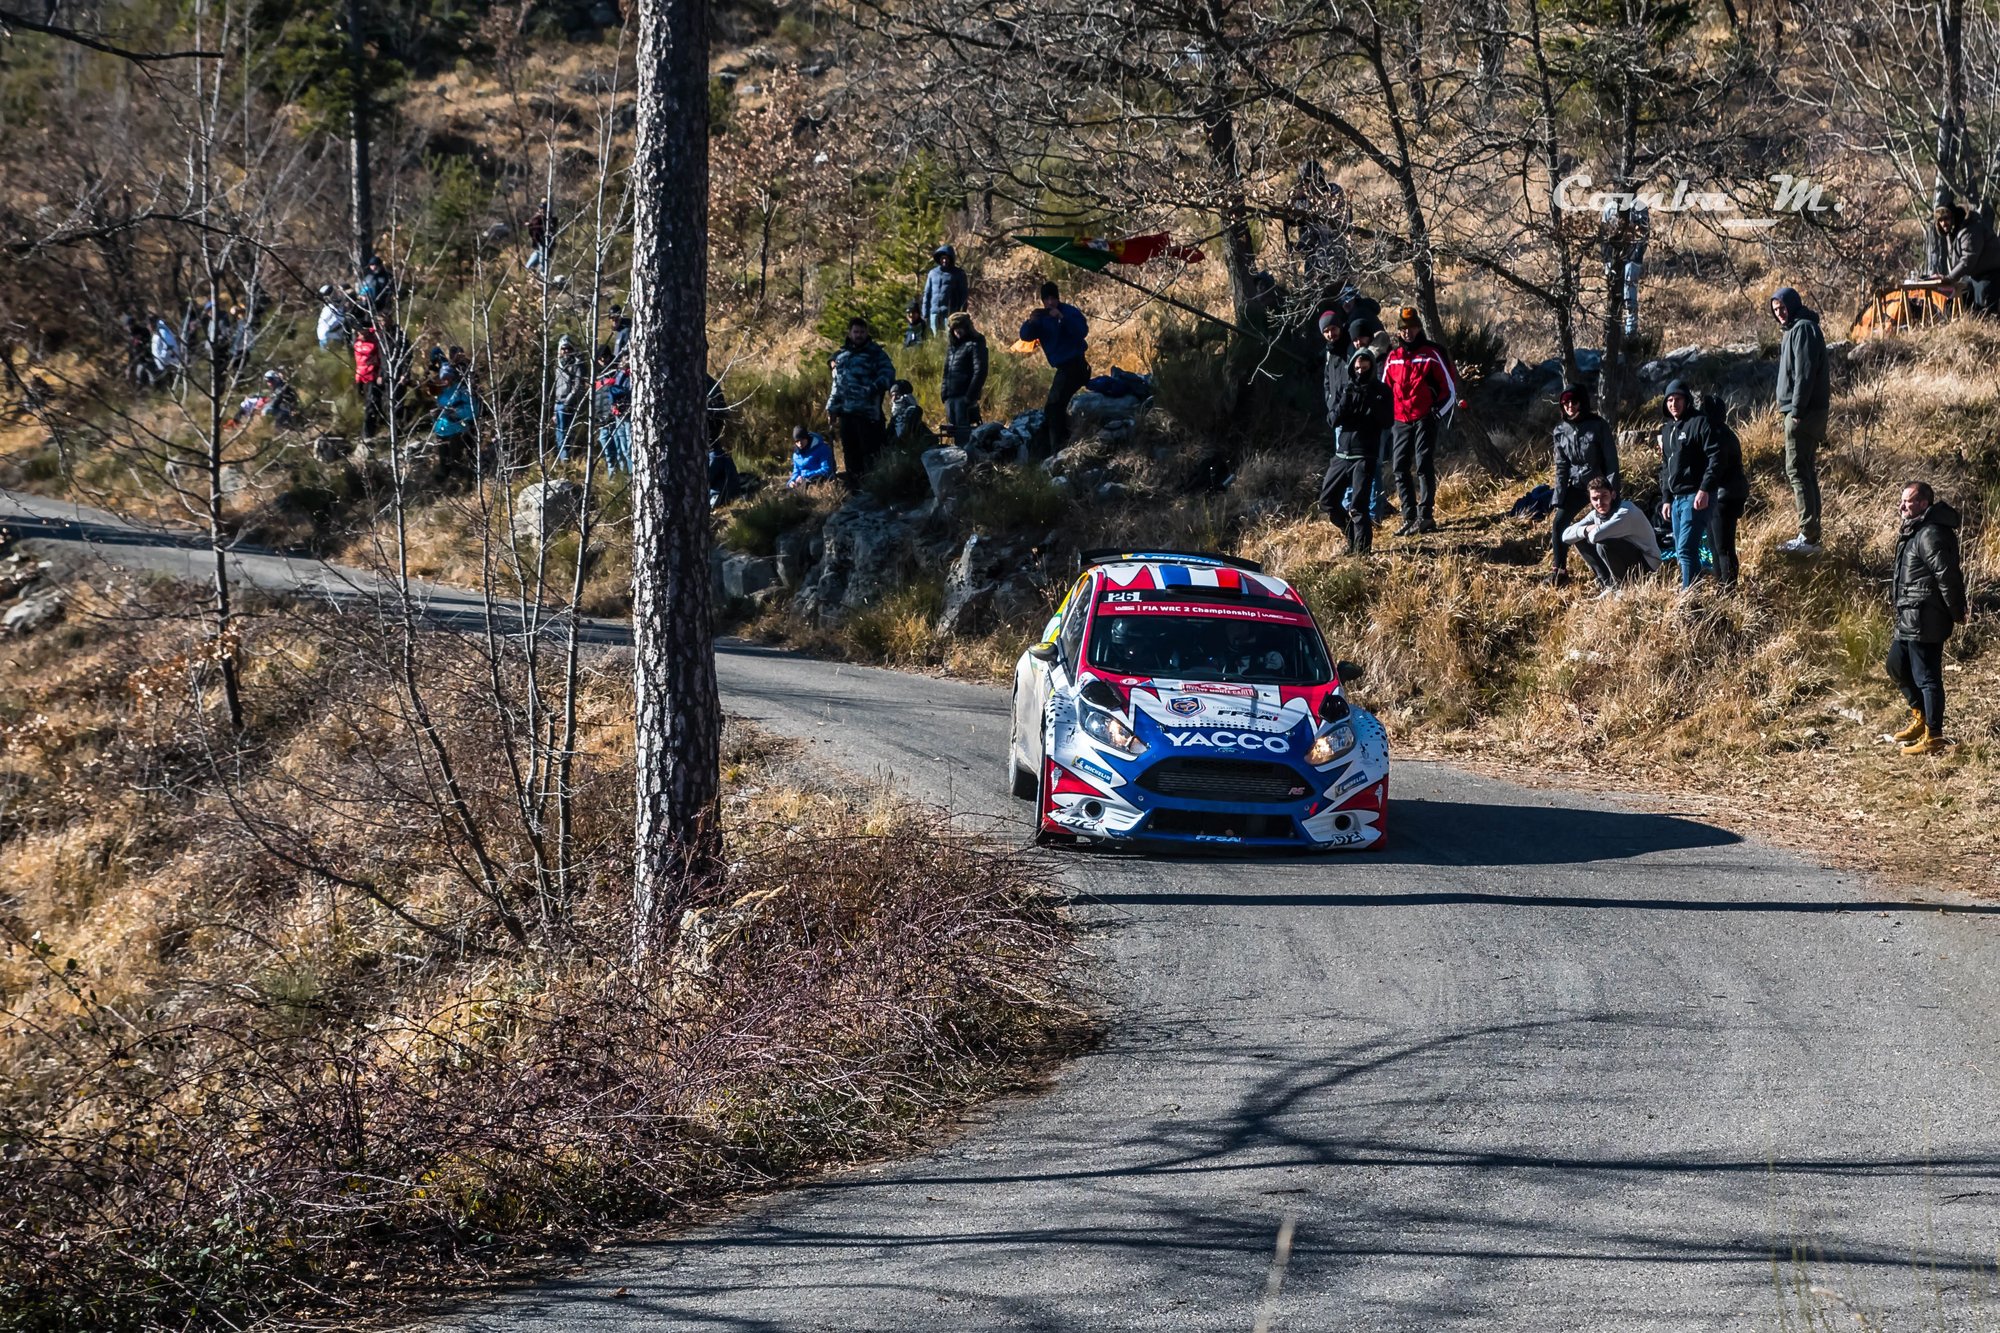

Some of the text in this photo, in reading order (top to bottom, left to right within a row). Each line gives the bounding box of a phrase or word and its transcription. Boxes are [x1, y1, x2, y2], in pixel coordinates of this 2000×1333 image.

[1112, 592, 1135, 601] 26
[1192, 606, 1257, 618] Championship
[1217, 709, 1273, 721] FFSA
[1163, 731, 1290, 754] YACCO
[1083, 764, 1112, 782] MICHELIN
